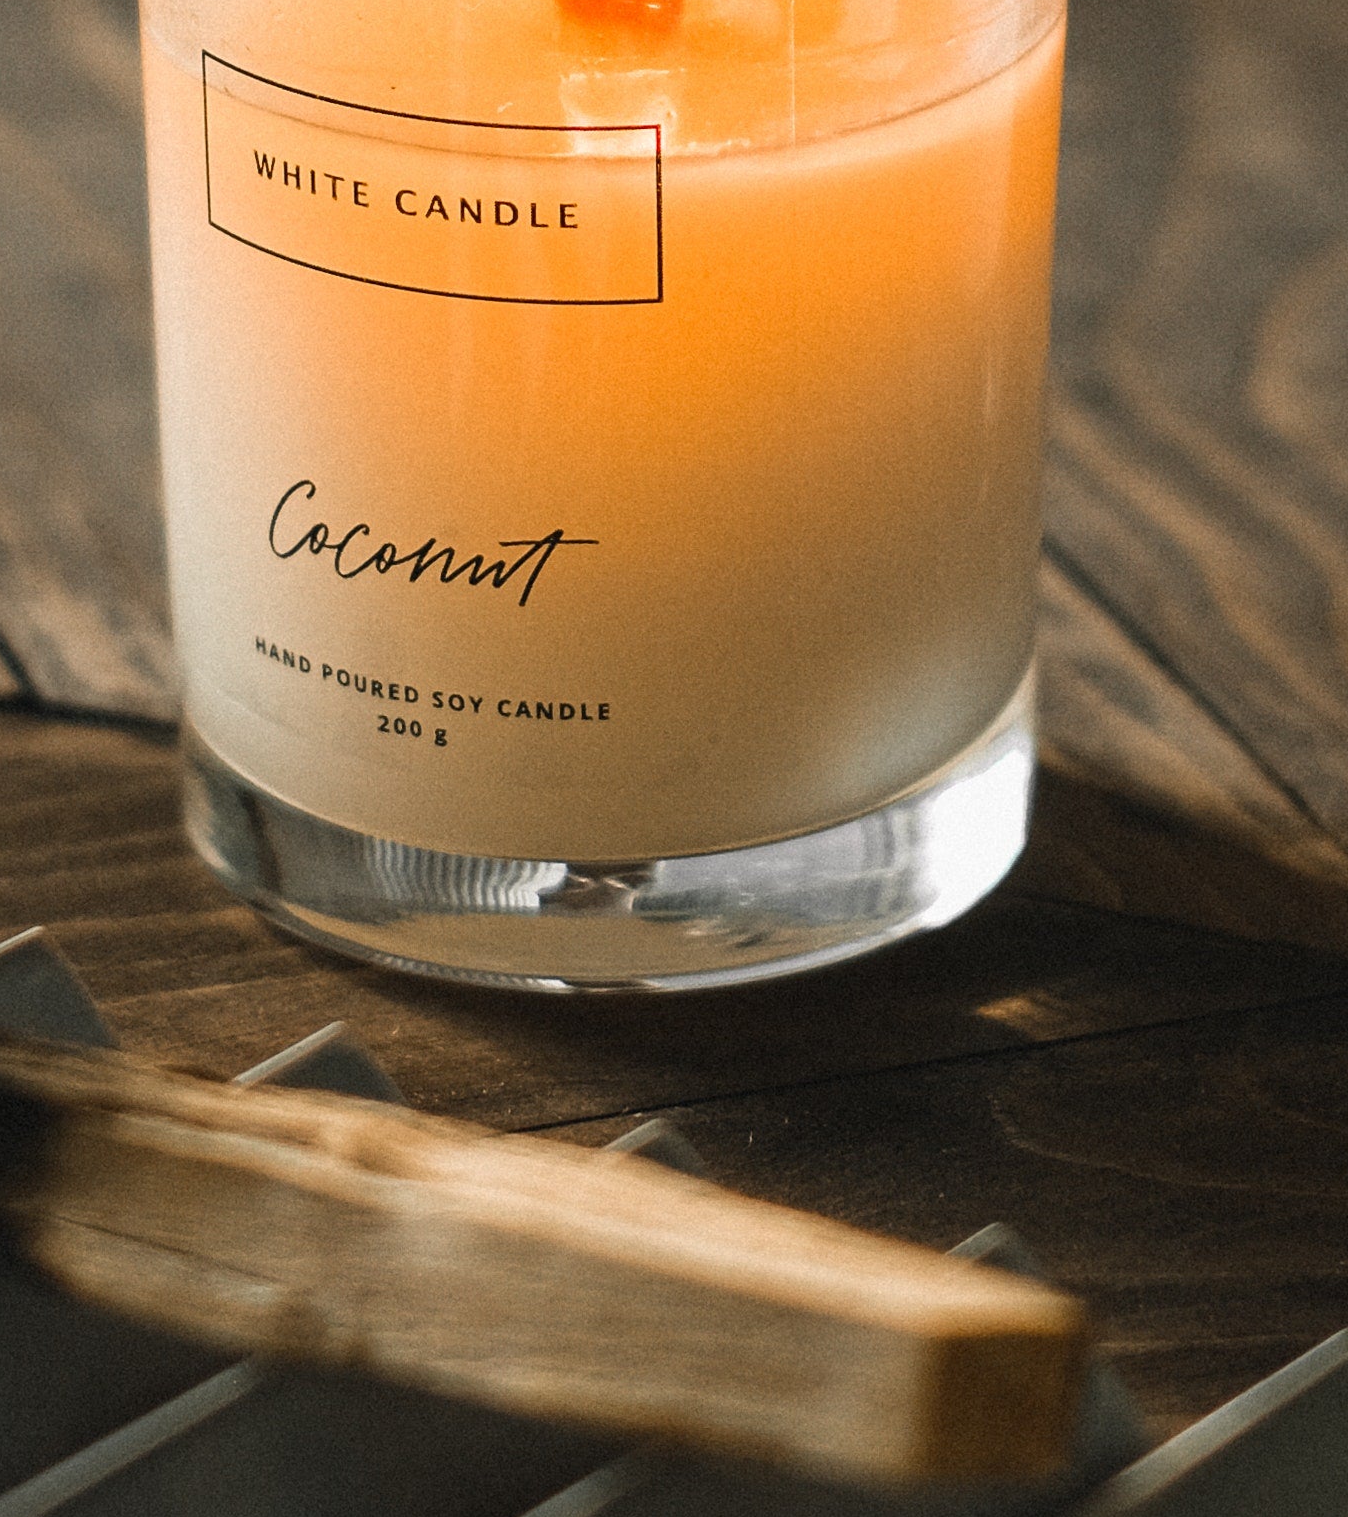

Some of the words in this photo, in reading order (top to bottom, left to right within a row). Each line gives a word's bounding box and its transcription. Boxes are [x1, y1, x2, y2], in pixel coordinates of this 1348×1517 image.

[253, 149, 370, 208] WHITE
[395, 189, 579, 229] CANDLE
[268, 479, 600, 607] Coconut
[254, 635, 312, 674] HAND
[321, 663, 420, 704] POURED
[431, 690, 484, 715] SOY
[496, 699, 612, 722] CANDLE
[376, 714, 423, 738] 200
[433, 727, 449, 748] g
